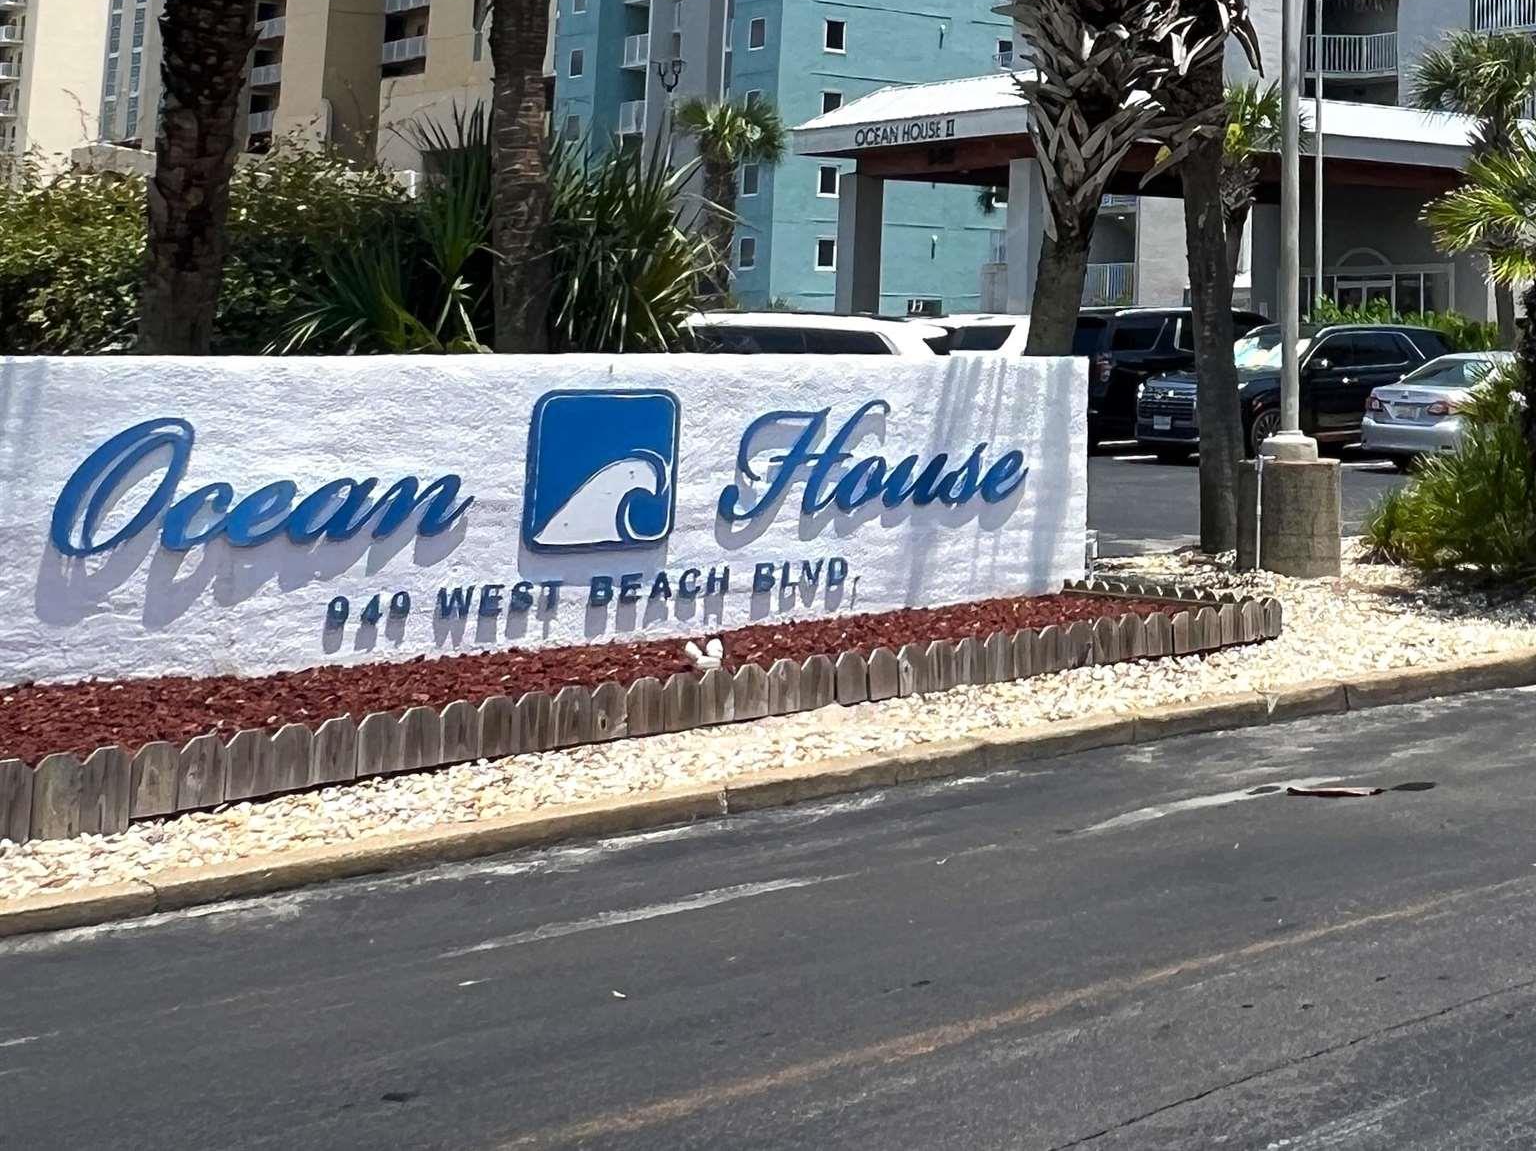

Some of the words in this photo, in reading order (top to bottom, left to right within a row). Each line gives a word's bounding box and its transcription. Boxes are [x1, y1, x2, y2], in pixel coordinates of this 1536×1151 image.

[854, 125, 899, 147] OCEAN
[902, 121, 941, 142] HOUSE
[51, 417, 476, 558] Ocean
[718, 399, 1029, 522] House
[325, 589, 410, 625] 949
[436, 579, 562, 619] WEST
[590, 565, 731, 607] BEACH
